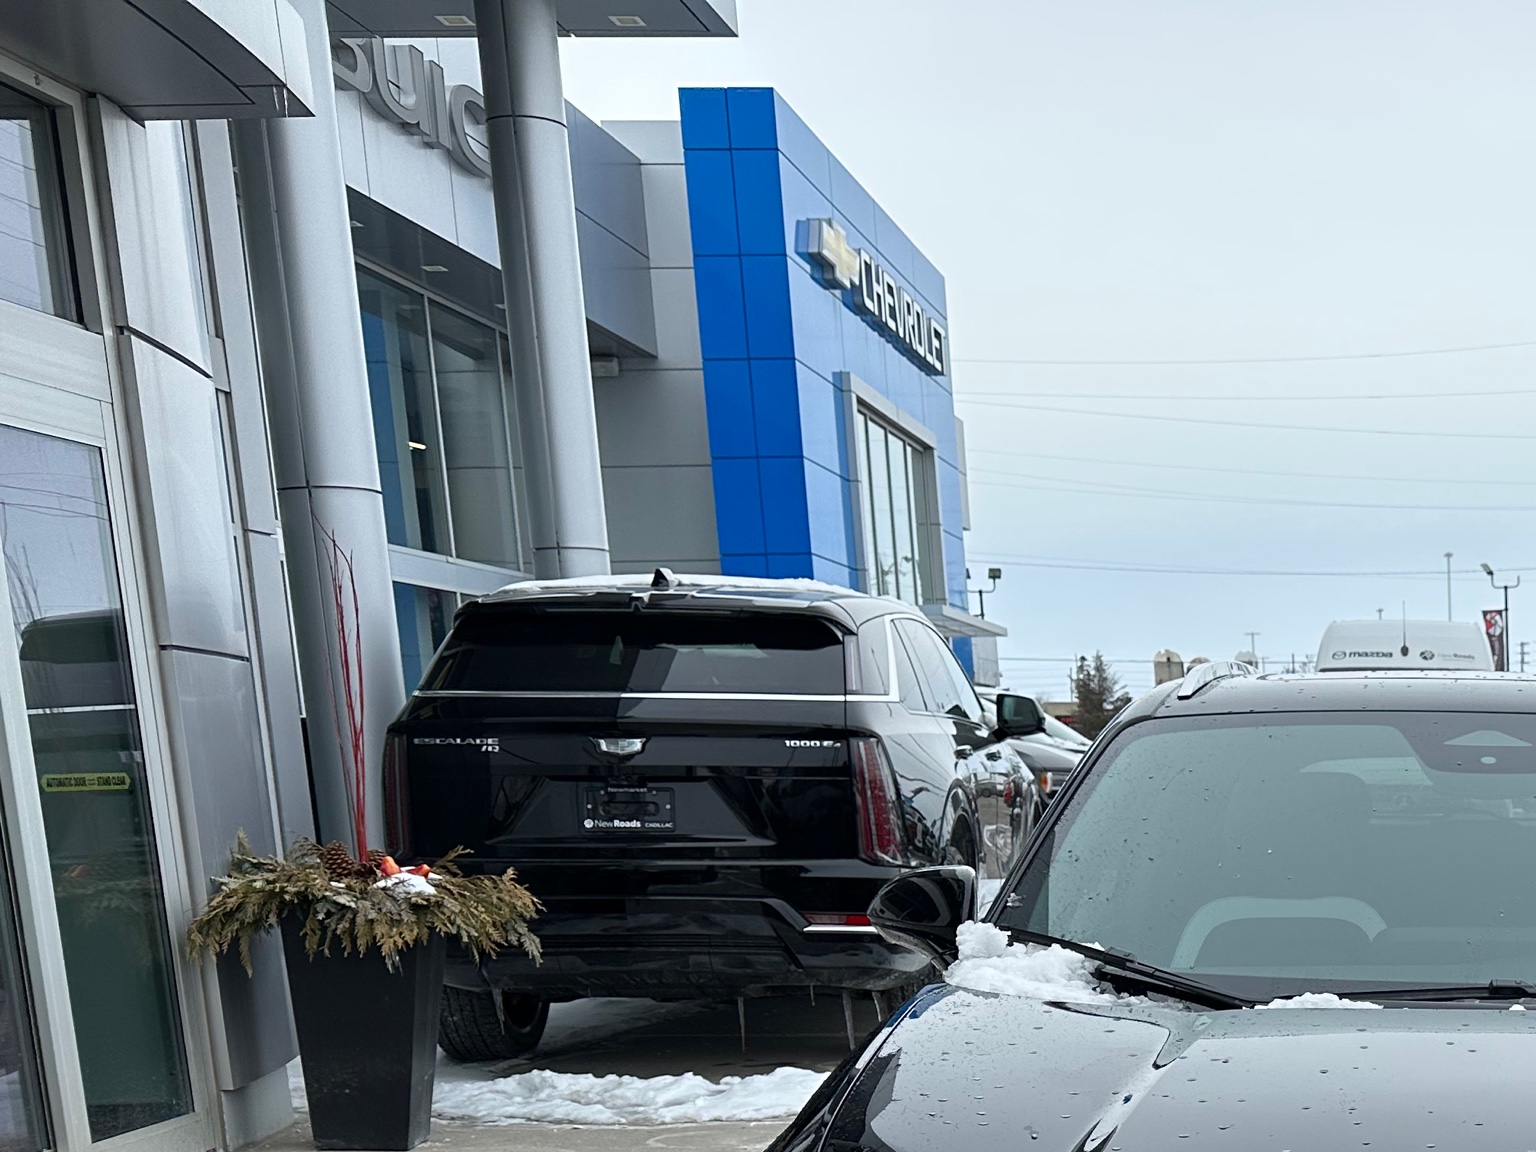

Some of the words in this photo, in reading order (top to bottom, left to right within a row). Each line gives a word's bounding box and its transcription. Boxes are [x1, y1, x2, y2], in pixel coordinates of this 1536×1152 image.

[860, 248, 946, 377] CHEVROLET
[413, 737, 500, 745] ESCALADE
[784, 739, 821, 747] 1000
